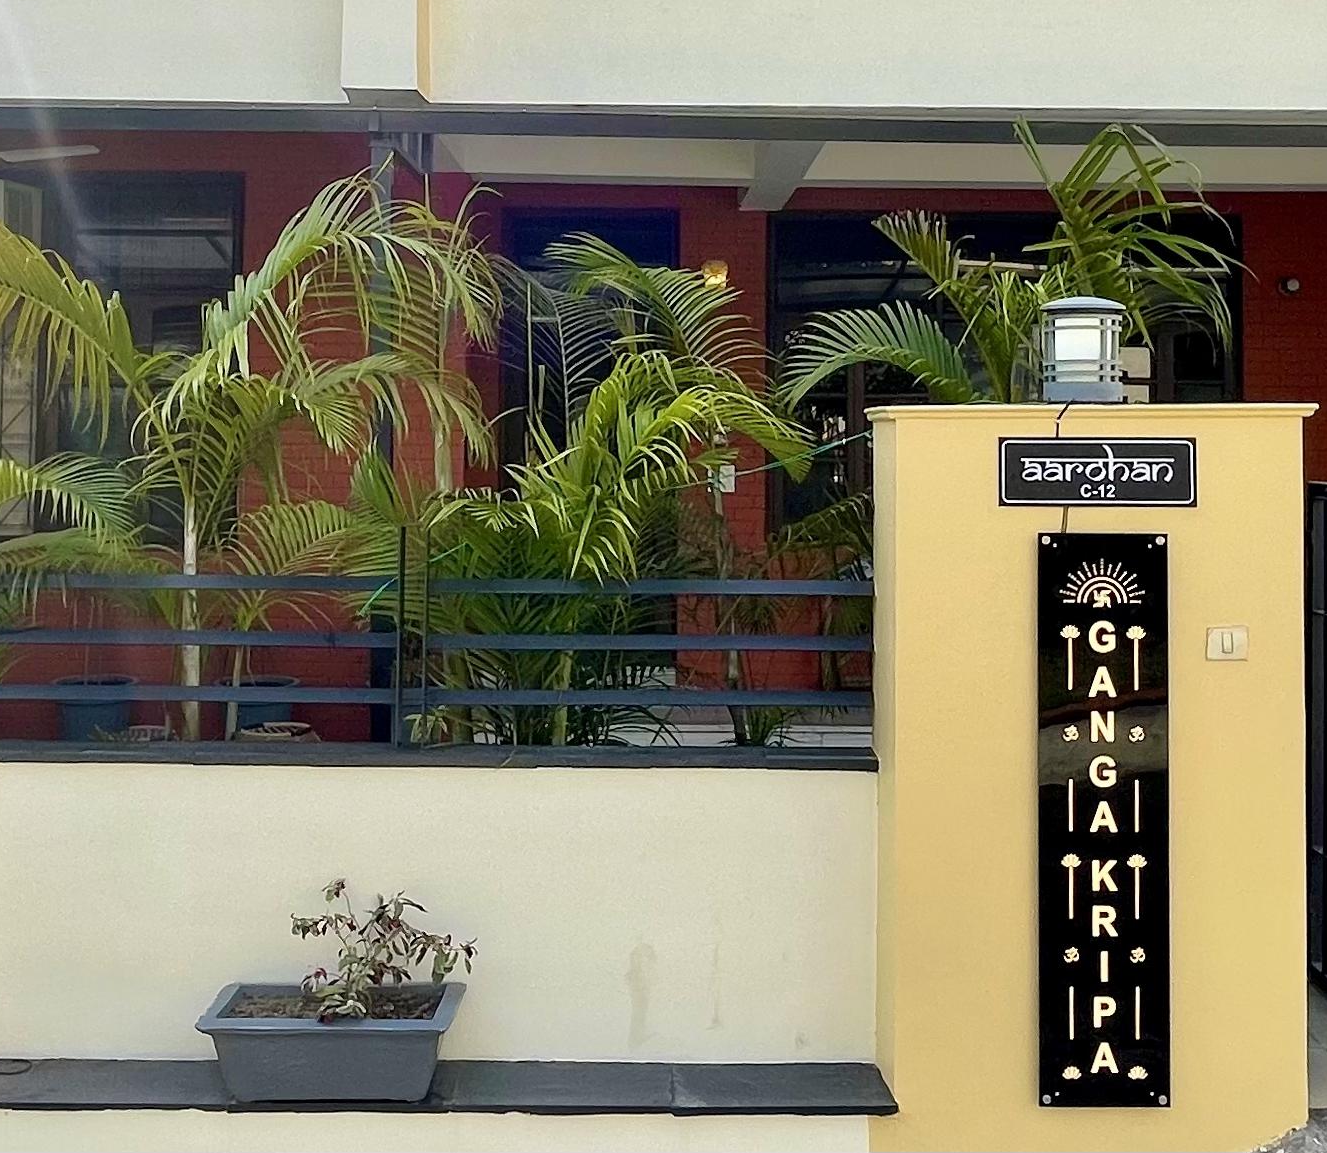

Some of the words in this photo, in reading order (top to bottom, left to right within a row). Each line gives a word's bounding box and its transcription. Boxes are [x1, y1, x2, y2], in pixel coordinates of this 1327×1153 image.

[1020, 444, 1175, 483] aarohan
[1079, 483, 1116, 498] C-12
[1087, 619, 1119, 834] GANGA
[1090, 858, 1120, 1074] KRIPA
